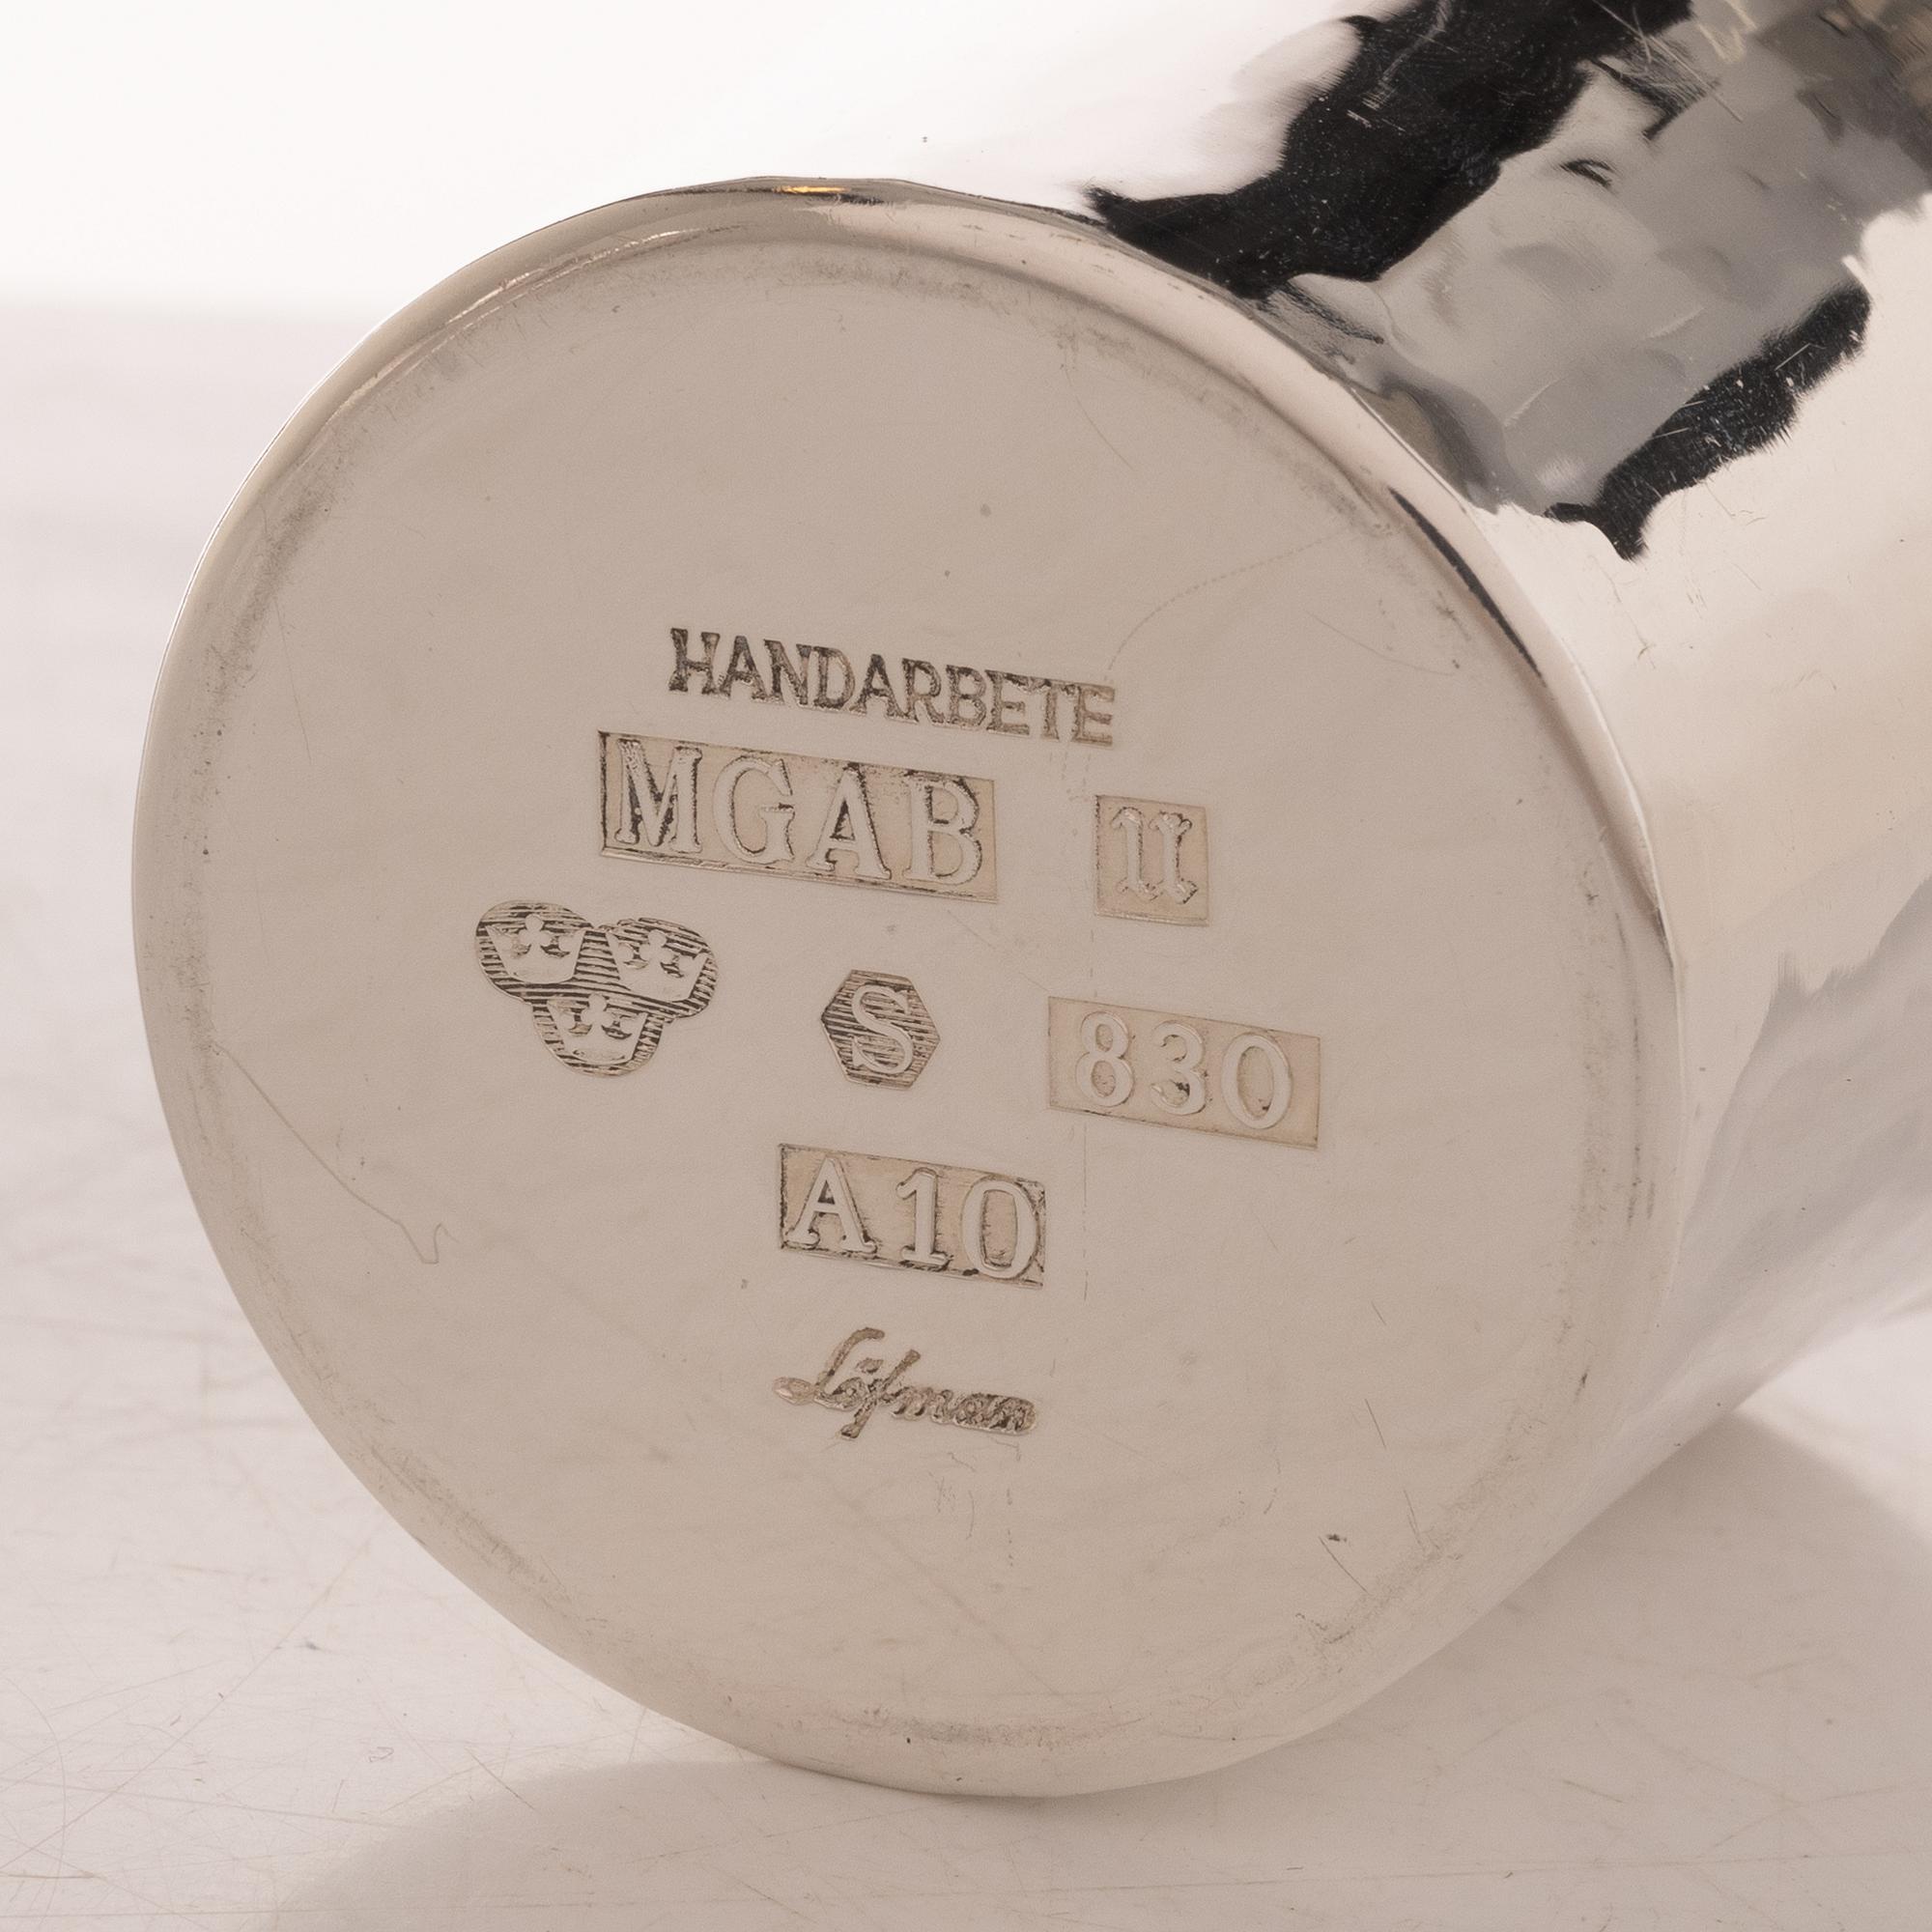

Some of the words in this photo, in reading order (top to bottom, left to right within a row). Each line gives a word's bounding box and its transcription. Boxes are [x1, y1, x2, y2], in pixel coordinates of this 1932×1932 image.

[668, 628, 1116, 745] HANDARBETE
[613, 737, 985, 887] MGAB
[849, 984, 914, 1075] S
[1074, 1010, 1294, 1130] 830
